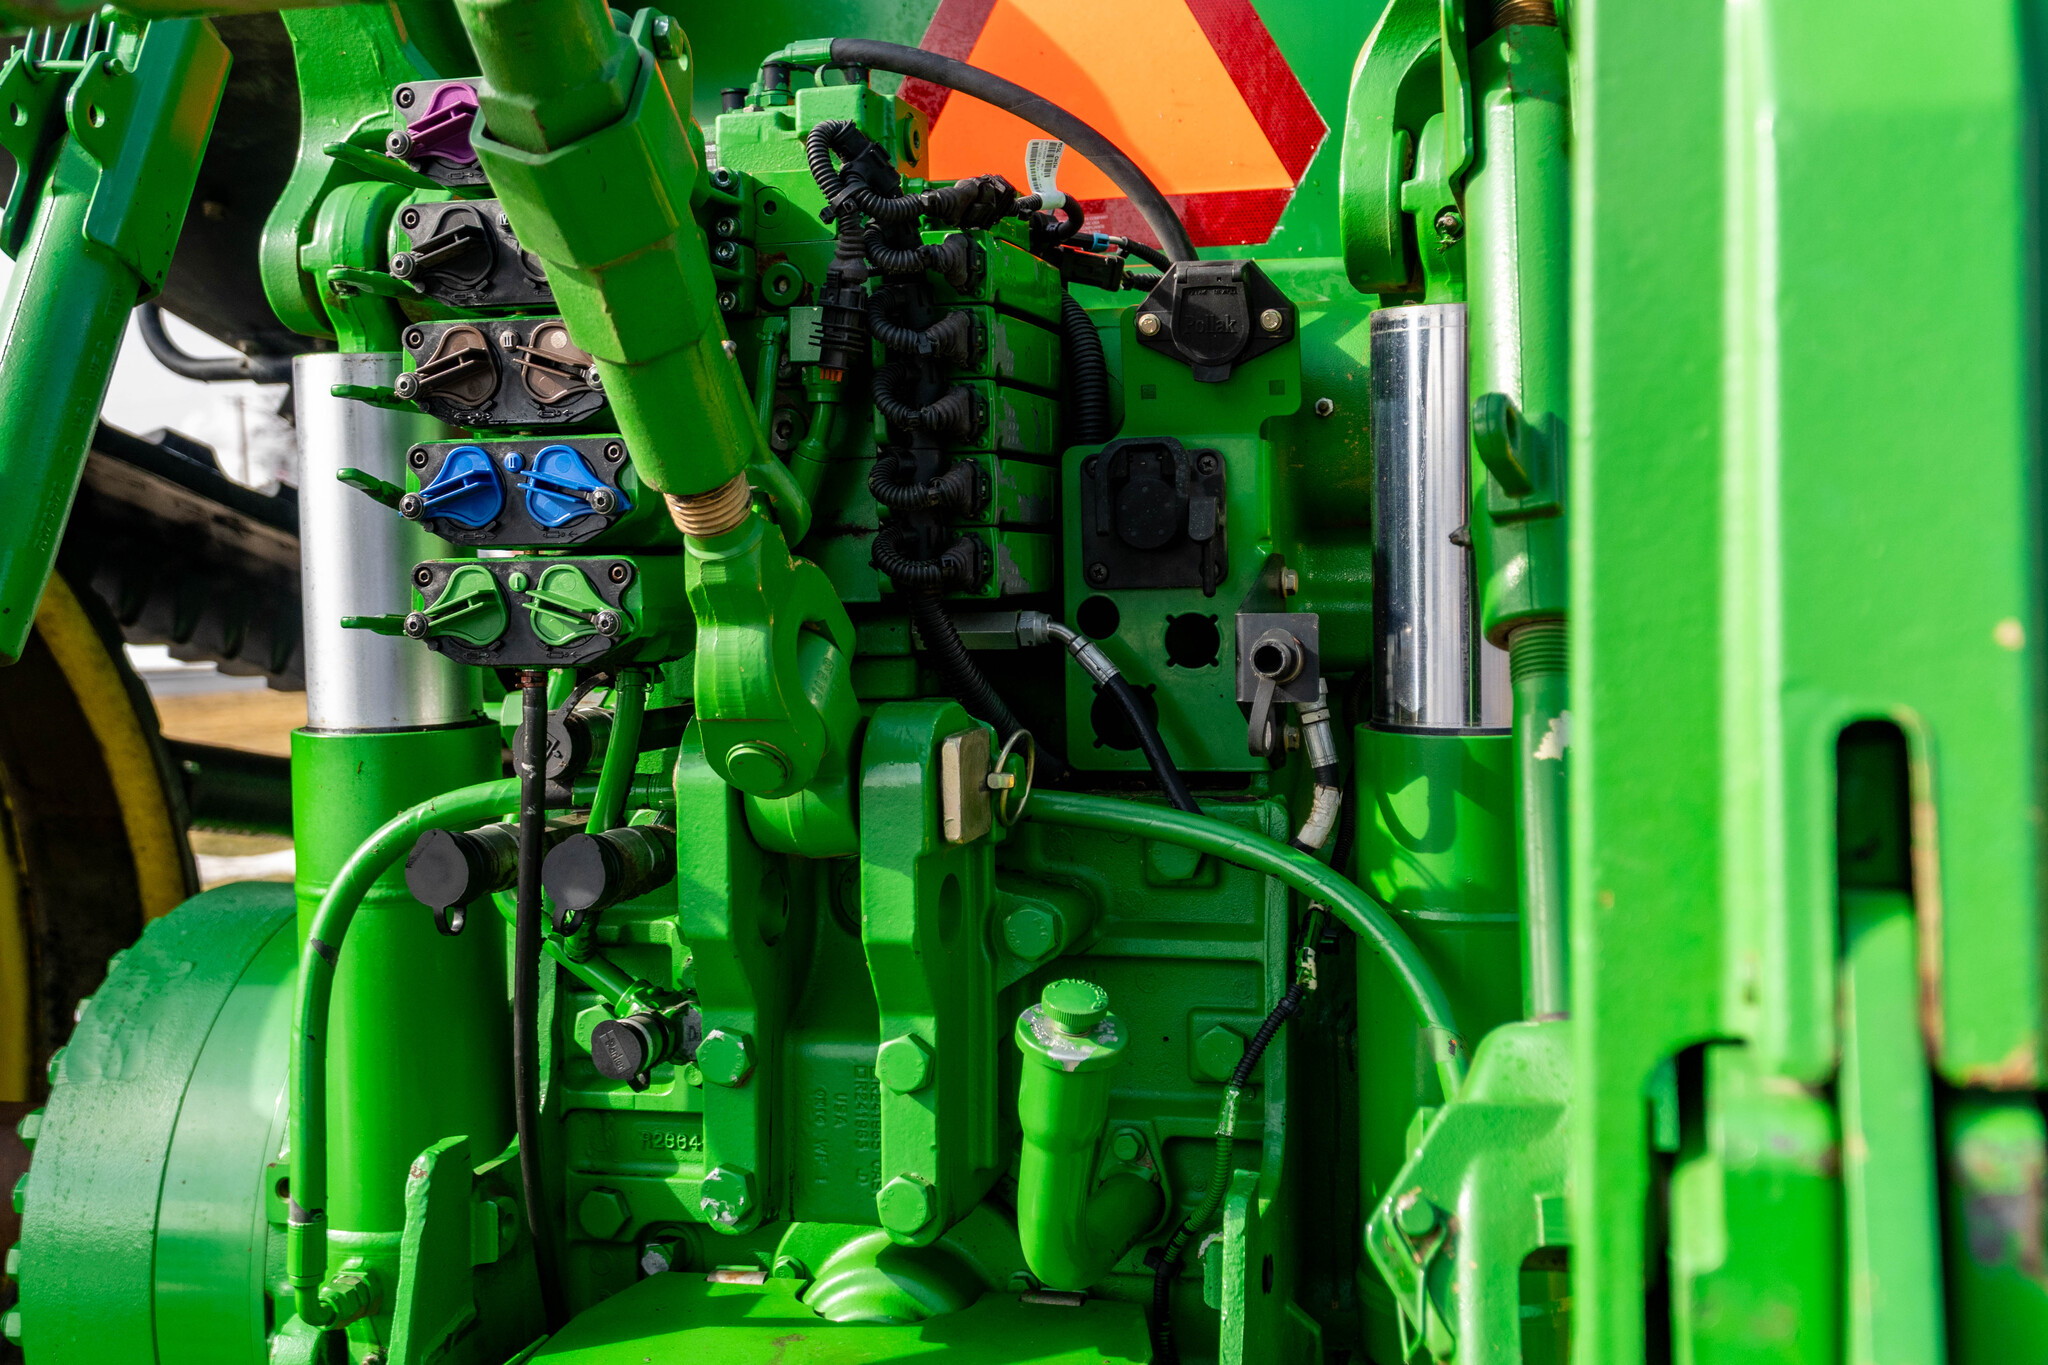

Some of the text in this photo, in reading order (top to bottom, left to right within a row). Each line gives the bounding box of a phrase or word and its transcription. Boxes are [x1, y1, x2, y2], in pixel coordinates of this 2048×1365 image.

[1184, 314, 1238, 334] Pollak
[503, 336, 514, 348] III
[508, 456, 516, 469] II
[834, 1093, 848, 1128] USA
